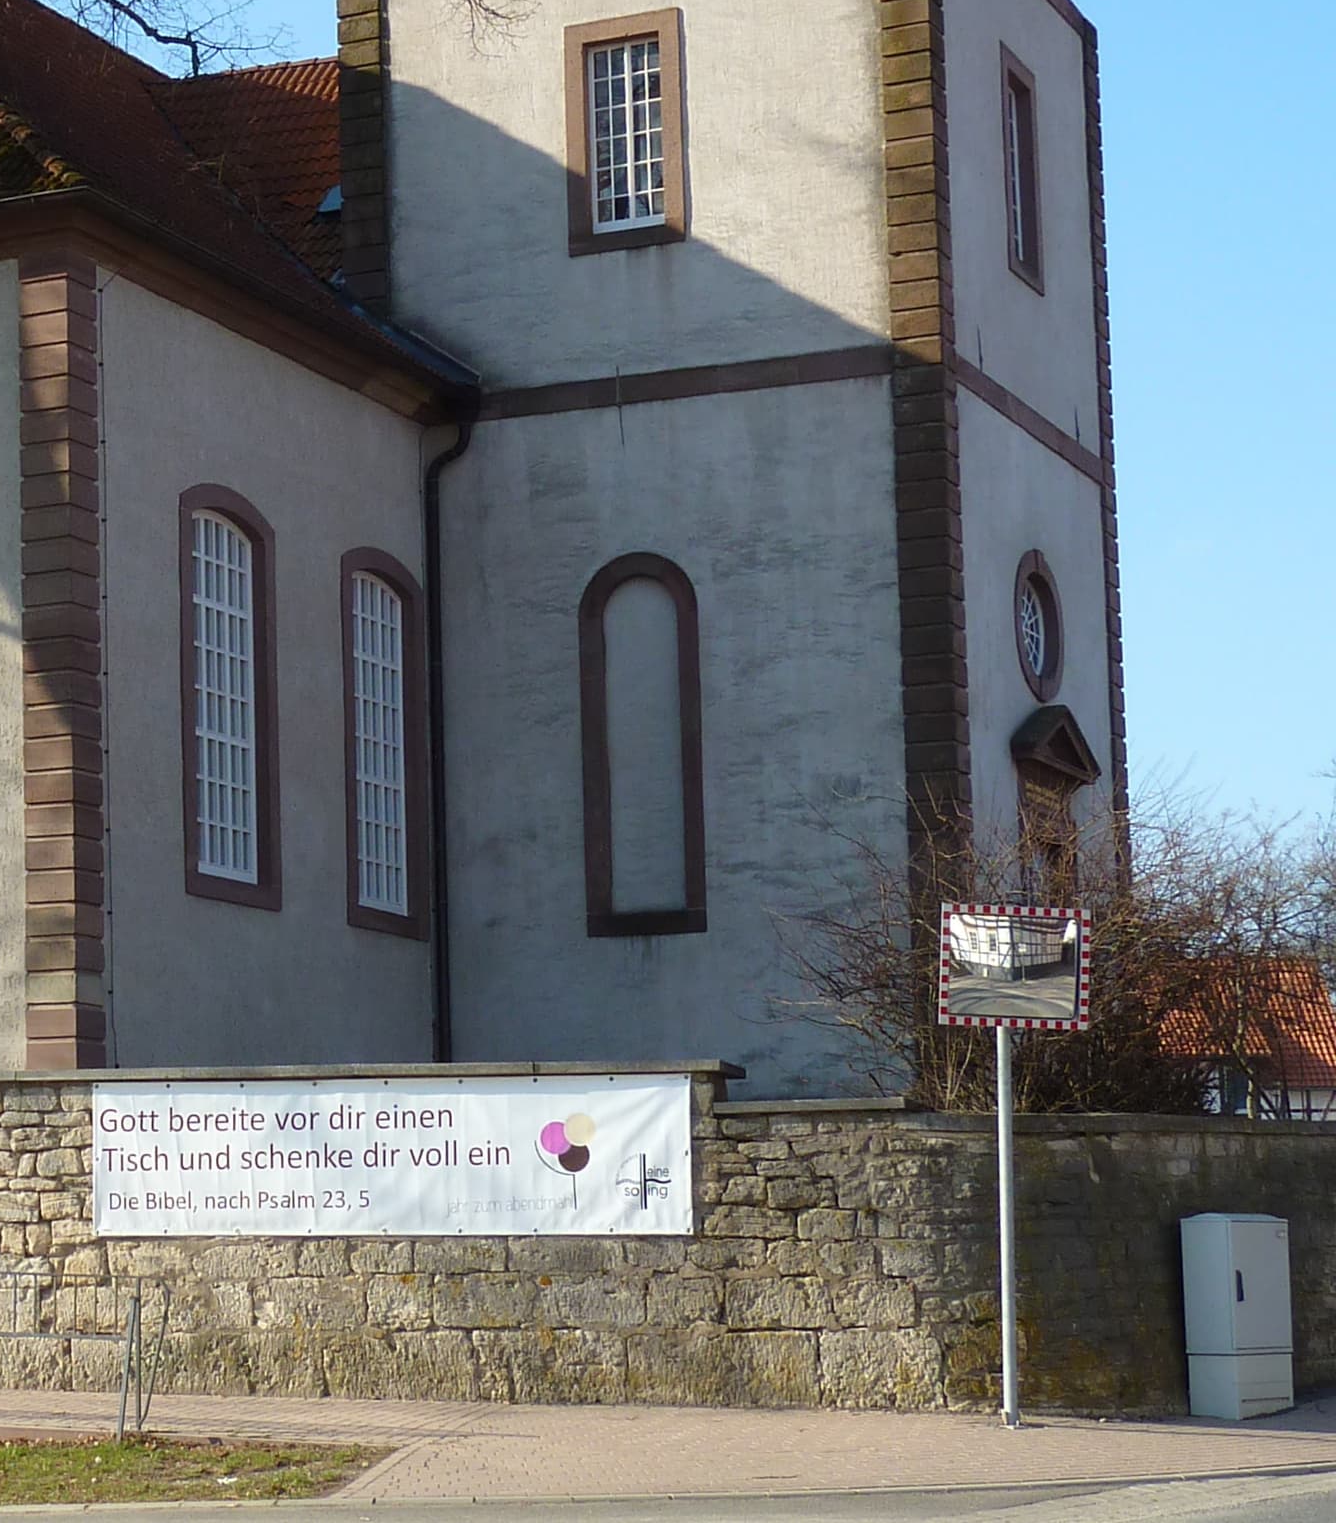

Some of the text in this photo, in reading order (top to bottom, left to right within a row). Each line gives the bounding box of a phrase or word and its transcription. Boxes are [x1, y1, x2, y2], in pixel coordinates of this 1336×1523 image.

[99, 1104, 454, 1133] Gott bereite vor dir einen
[102, 1140, 511, 1173] Tisch und schenke dir voll ein
[109, 1189, 370, 1214] Die Bibel, nach Psalm 23, 5
